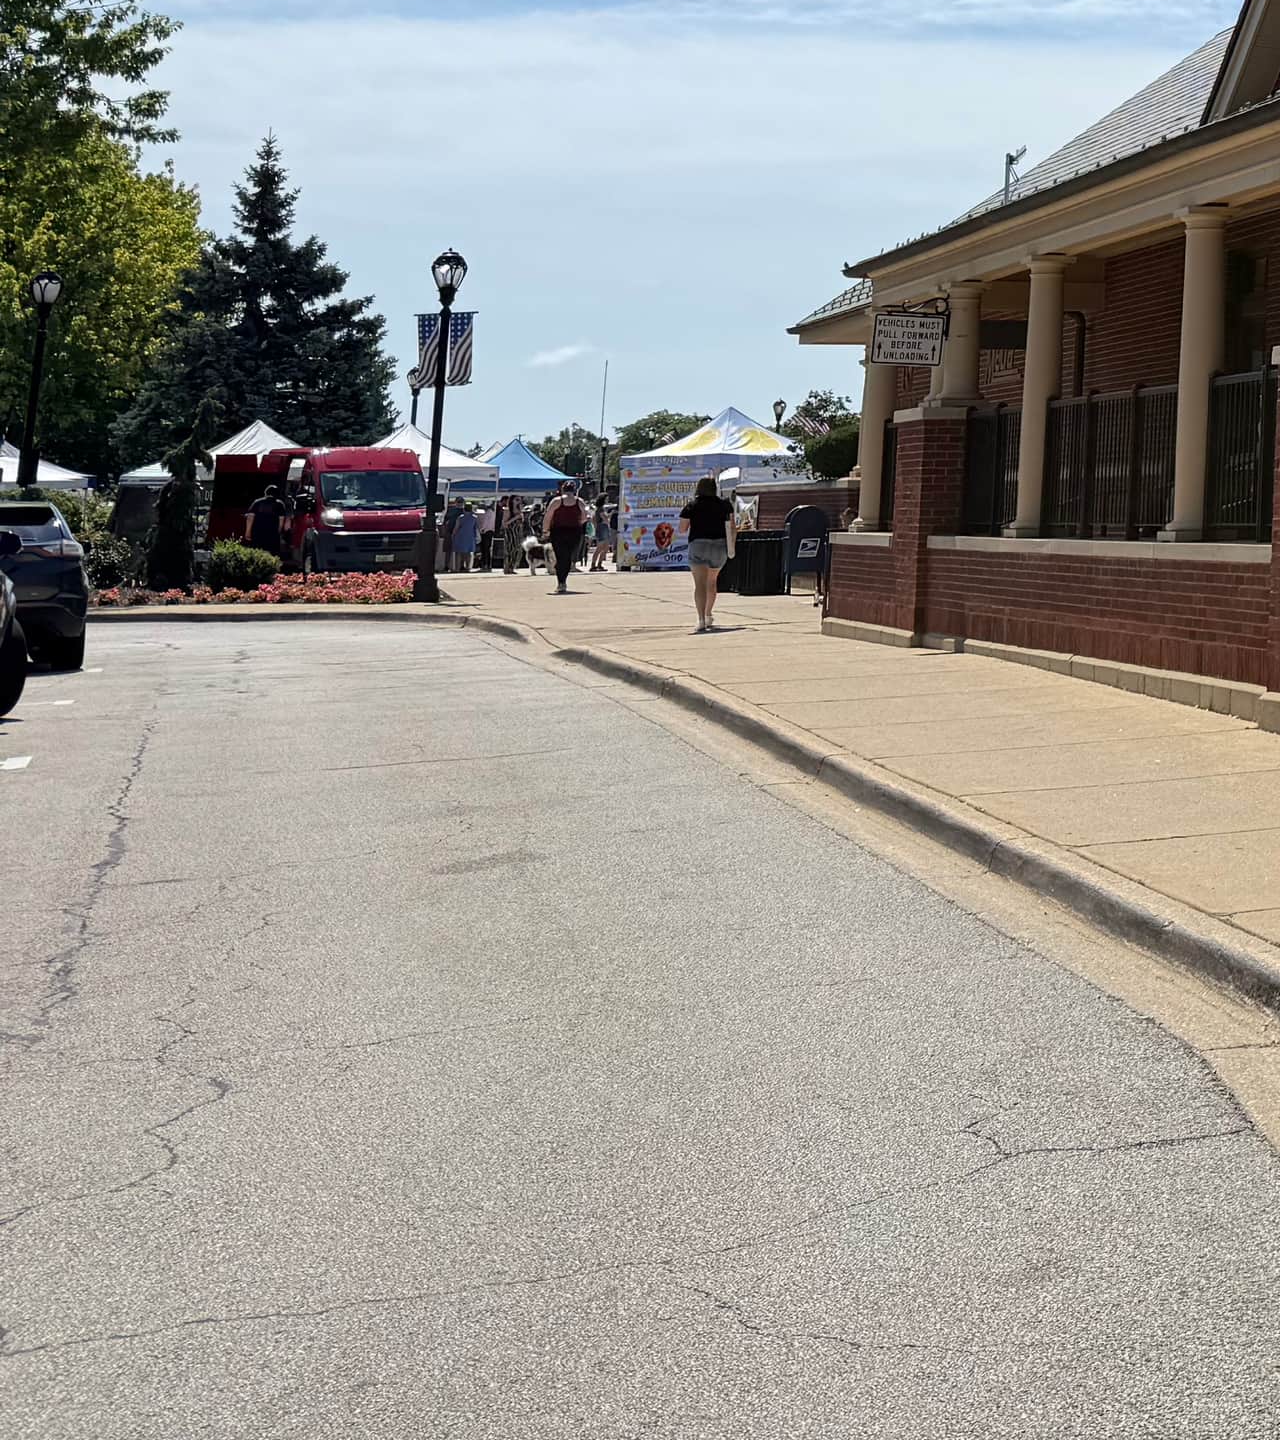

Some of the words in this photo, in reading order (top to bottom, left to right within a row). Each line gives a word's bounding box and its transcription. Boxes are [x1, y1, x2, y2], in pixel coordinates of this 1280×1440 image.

[878, 318, 916, 329] VEHICLES
[919, 321, 941, 330] MUST
[878, 329, 898, 339] PULL
[902, 331, 940, 341] FORWARD
[890, 341, 923, 350] BEFORE
[883, 351, 929, 361] UNLOADING
